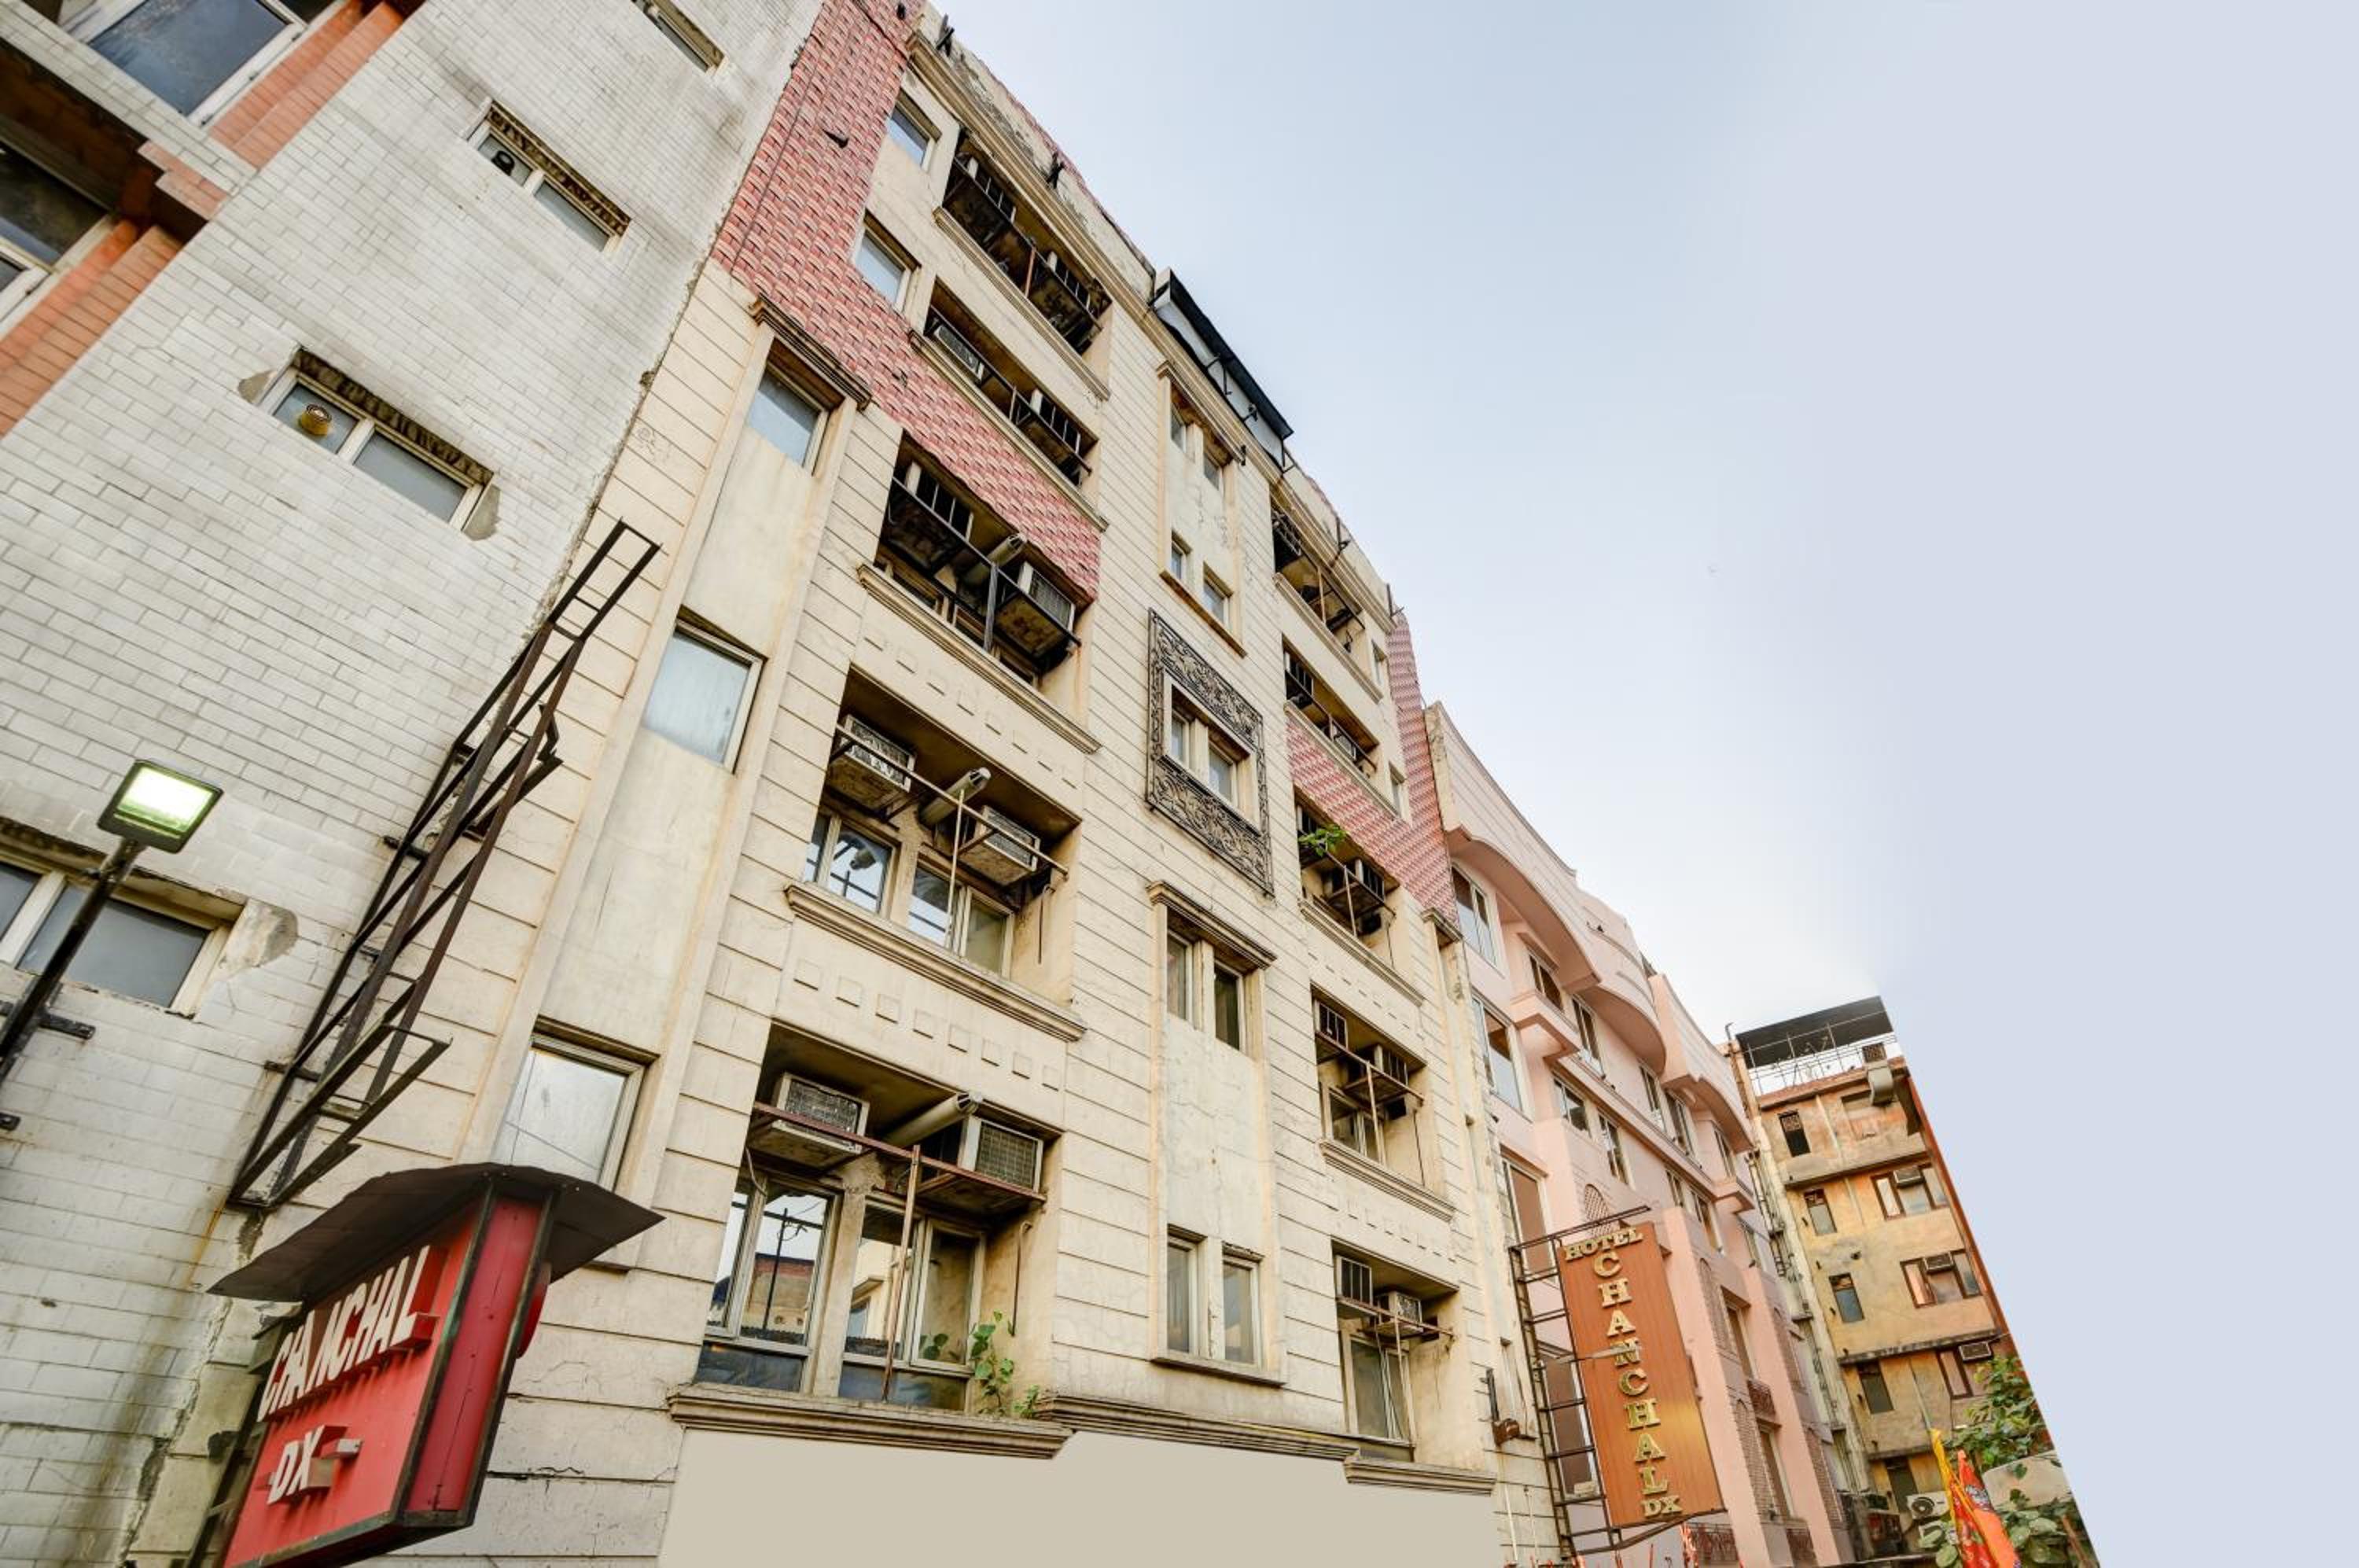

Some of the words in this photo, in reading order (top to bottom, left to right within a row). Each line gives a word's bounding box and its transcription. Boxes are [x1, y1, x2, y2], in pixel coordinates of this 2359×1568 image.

[1563, 1227, 1643, 1261] HOTEL
[257, 1246, 429, 1422] CHANCHAL
[1594, 1251, 1669, 1494] CHANCHAL
[1640, 1495, 1682, 1517] DX
